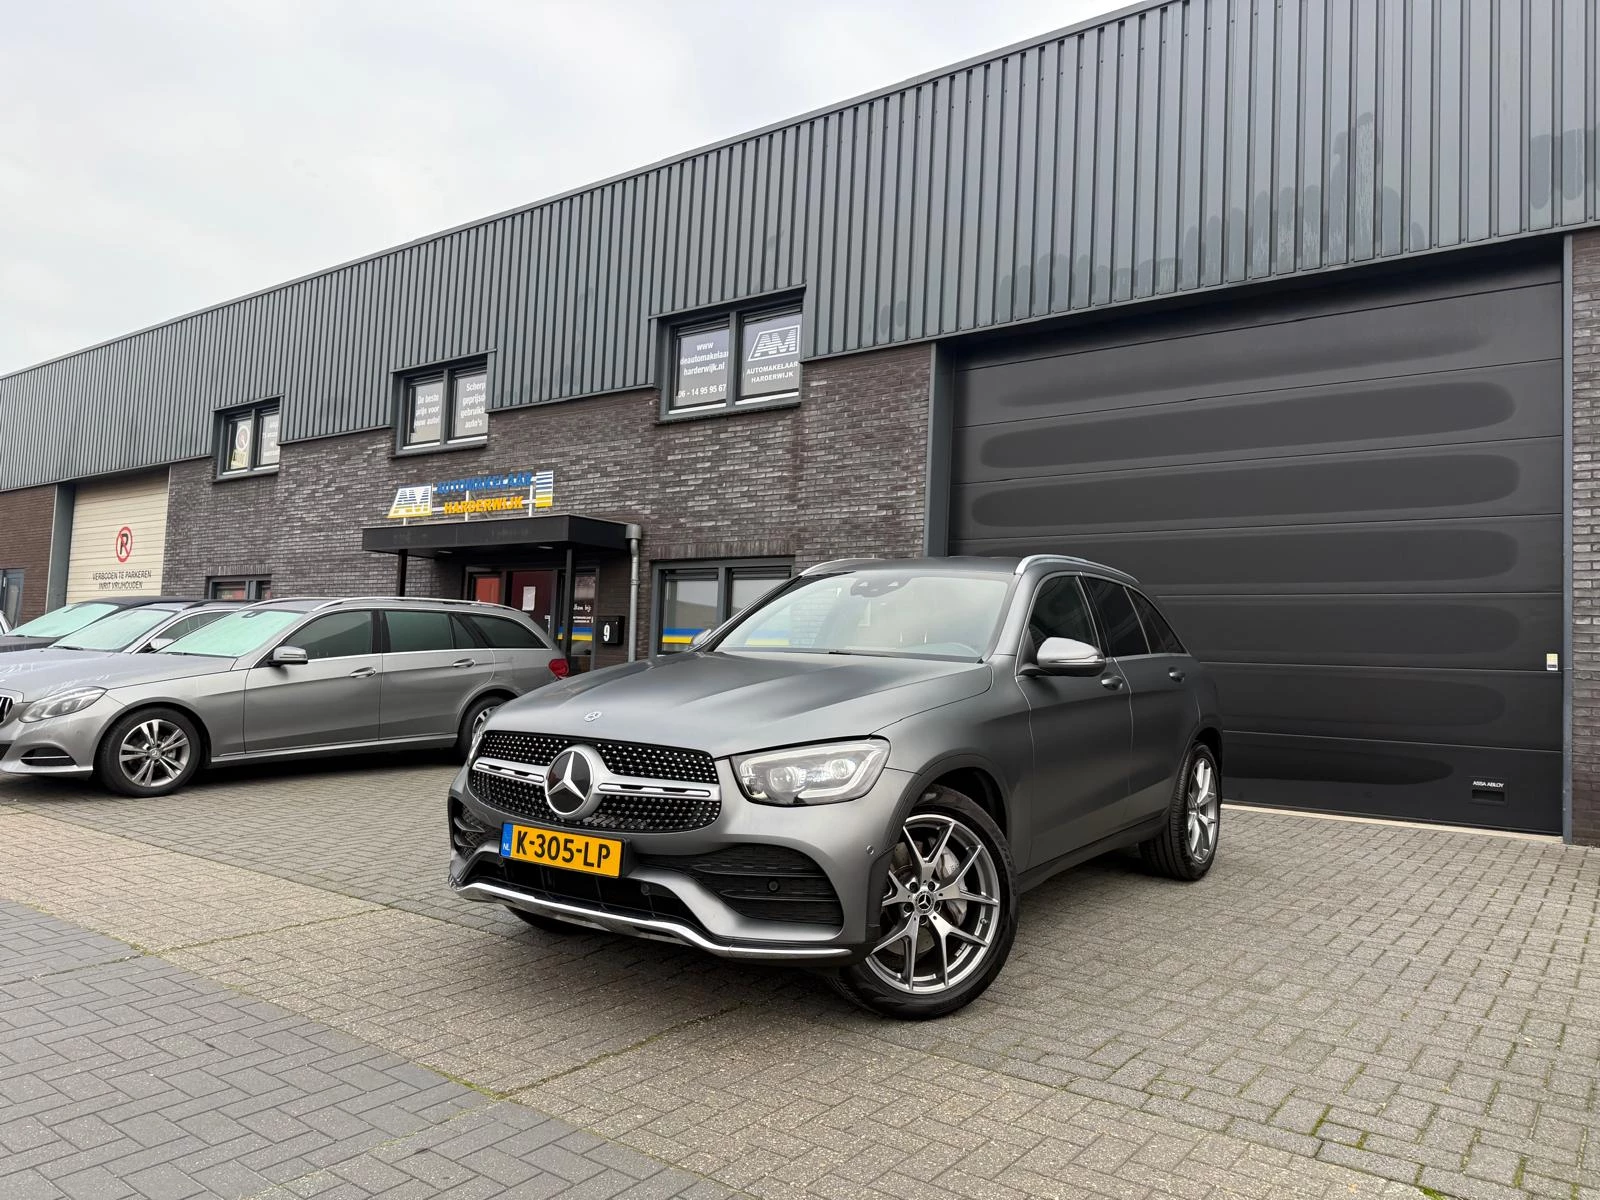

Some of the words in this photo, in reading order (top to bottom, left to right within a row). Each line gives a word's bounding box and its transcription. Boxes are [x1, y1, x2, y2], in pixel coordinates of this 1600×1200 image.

[697, 342, 714, 351] www
[683, 361, 725, 376] harderwijk.nl
[746, 361, 799, 375] AUTOMAKELAAR
[751, 371, 794, 383] HARDERWIJK
[466, 382, 486, 391] Scherp
[691, 388, 699, 396] 14
[700, 386, 708, 395] 95
[709, 385, 717, 393] 95
[718, 384, 727, 392] 67
[437, 472, 533, 493] AUTOMAKELAAR
[444, 496, 524, 514] HARDERWIJK
[93, 572, 117, 580] VERBODEN
[118, 571, 125, 579] TE
[125, 570, 151, 578] PARKEREN
[603, 624, 611, 642] 9
[503, 843, 510, 851] NL
[516, 830, 611, 868] K-305-LP
